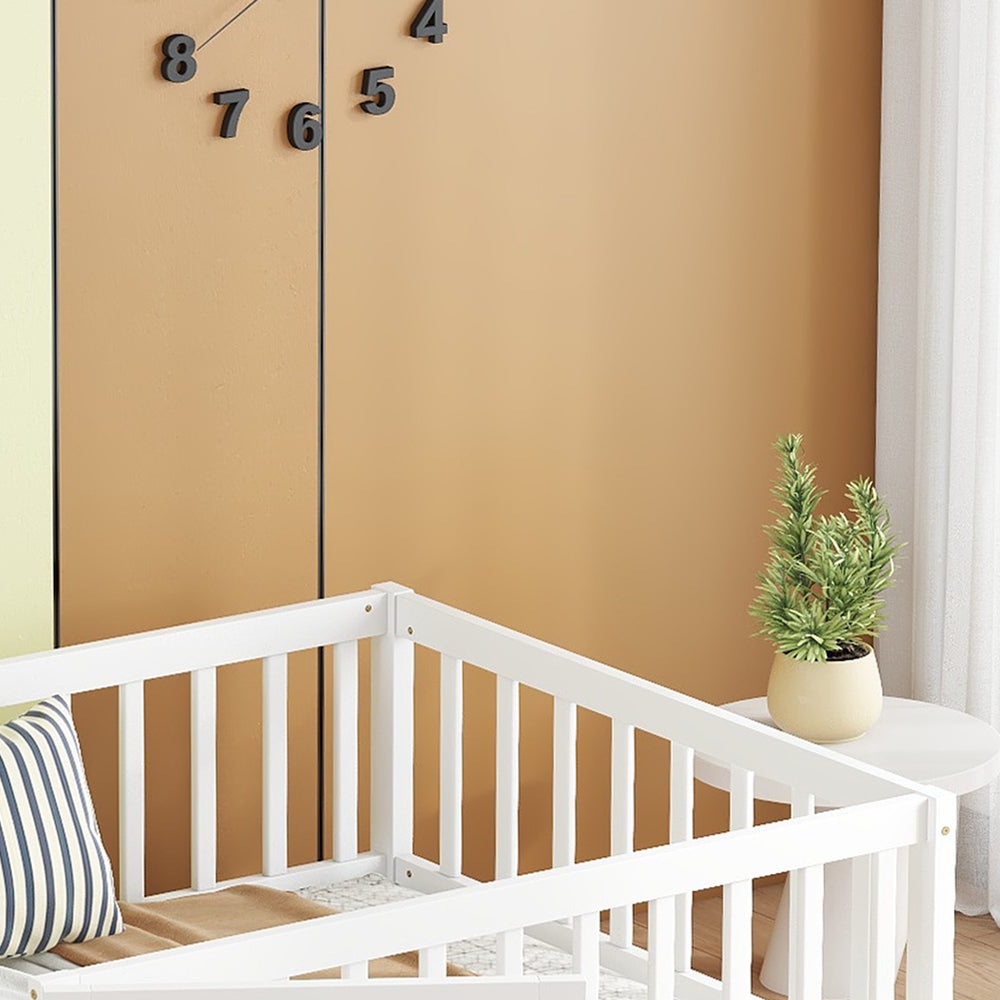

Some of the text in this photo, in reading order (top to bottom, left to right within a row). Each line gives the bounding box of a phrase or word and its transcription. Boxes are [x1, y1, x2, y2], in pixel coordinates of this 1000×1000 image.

[409, 0, 448, 44] 4
[160, 33, 197, 83] 8
[212, 87, 250, 139] 7
[359, 65, 396, 116] 5
[286, 101, 324, 152] 6
